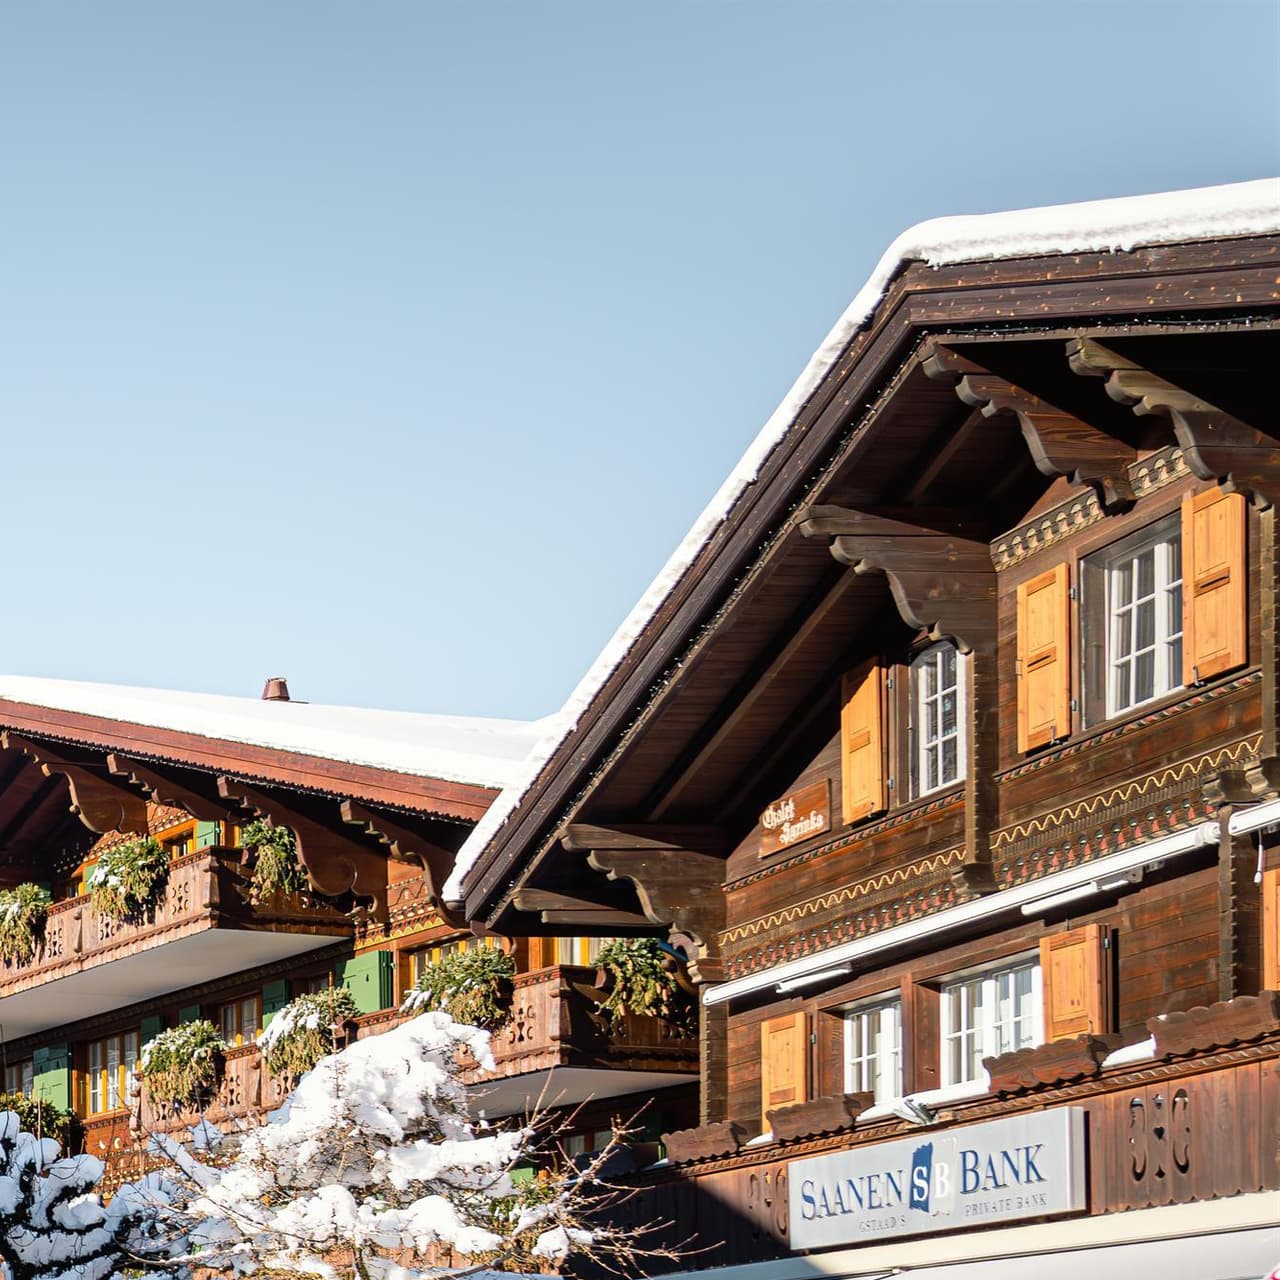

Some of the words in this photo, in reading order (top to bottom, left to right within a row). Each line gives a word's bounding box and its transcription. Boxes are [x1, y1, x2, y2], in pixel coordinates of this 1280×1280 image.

[800, 1170, 904, 1221] SAANEN
[959, 1144, 1047, 1195] BANK
[965, 1198, 1012, 1217] PRIVATE
[1016, 1193, 1048, 1210] BANK
